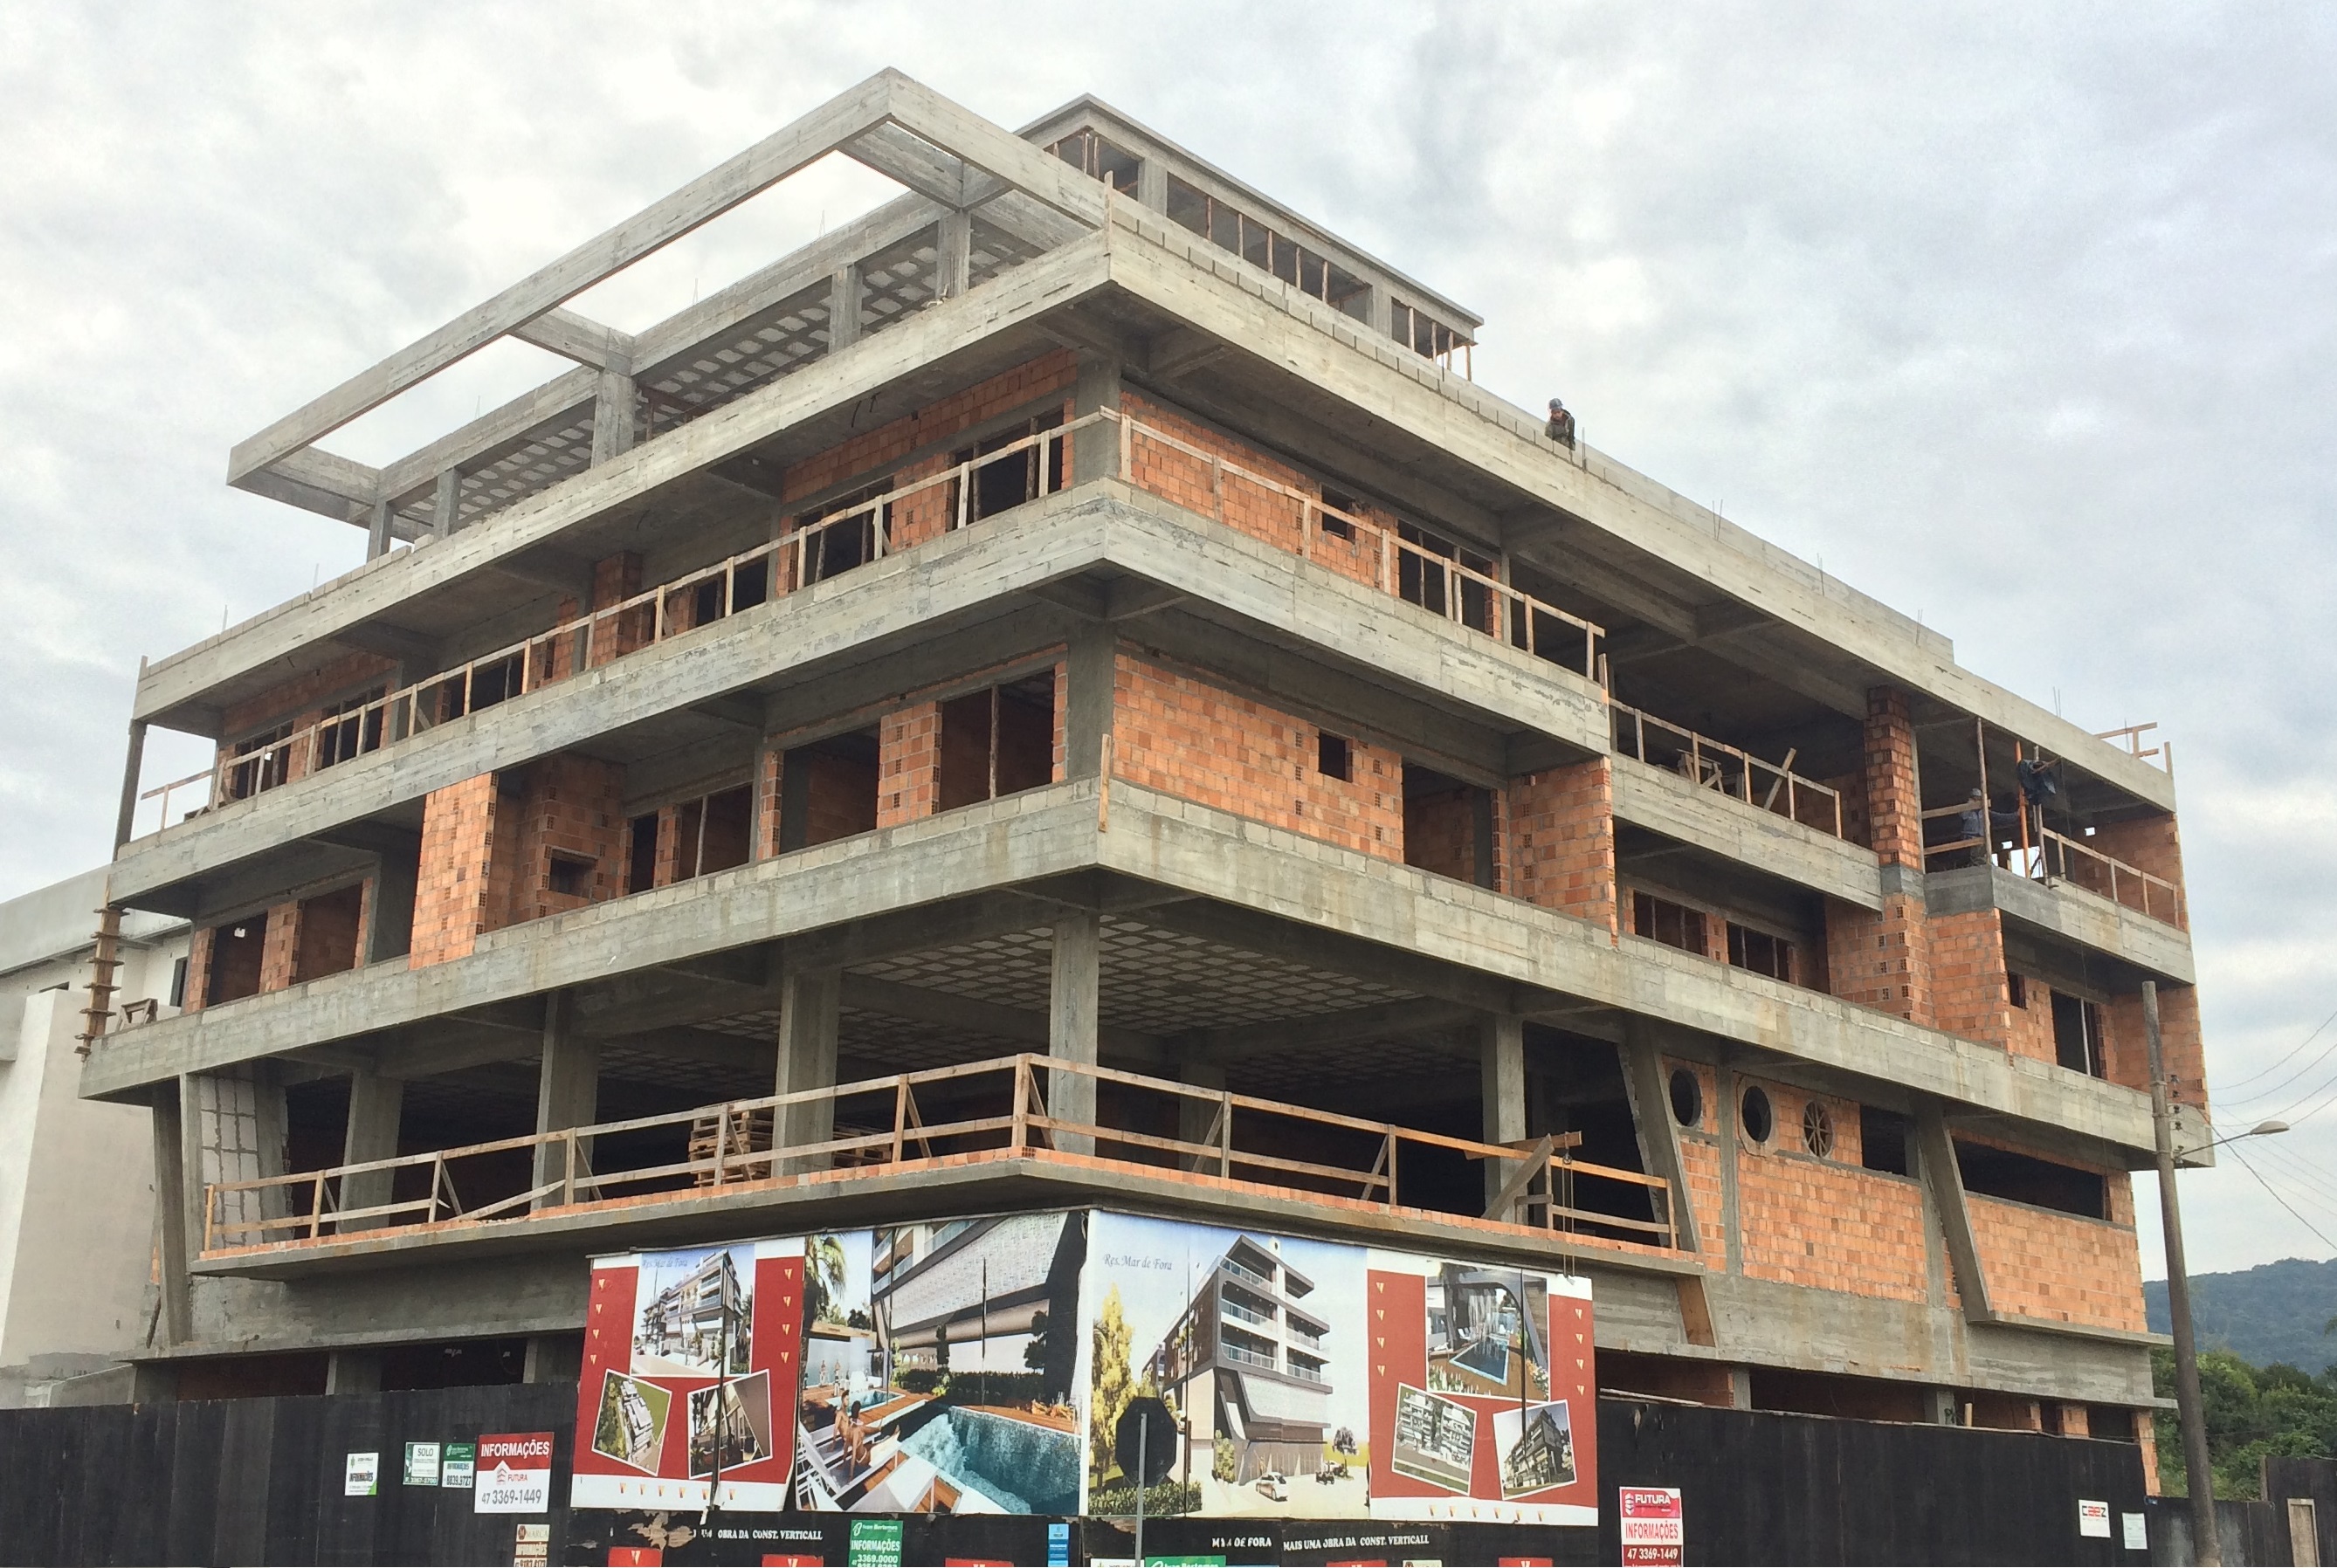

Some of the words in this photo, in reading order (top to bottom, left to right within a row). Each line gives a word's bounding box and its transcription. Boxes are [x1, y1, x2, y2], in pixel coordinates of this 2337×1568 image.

[1121, 1255, 1141, 1267] Mar
[1141, 1255, 1152, 1269] de
[1153, 1259, 1173, 1270] Fora
[417, 1448, 434, 1457] SOLO
[481, 1439, 550, 1459] INFORMAÇÕES
[507, 1474, 528, 1482] FUTURA
[481, 1492, 491, 1504] 47
[1635, 1494, 1671, 1504] FUTURA
[717, 1530, 738, 1539] OBRA
[738, 1530, 749, 1539] DA
[752, 1530, 779, 1540] CONST.
[780, 1530, 823, 1540] VERTICALL
[1625, 1520, 1679, 1543] INFORMAÇÕES
[851, 1538, 900, 1554] INFORMAÇÕES
[1247, 1537, 1272, 1547] FORA
[1283, 1541, 1303, 1551] MAIS
[1303, 1540, 1321, 1550] UMA
[1345, 1537, 1356, 1546] DA
[1360, 1537, 1387, 1546] CONST.
[1388, 1535, 1430, 1545] VERTICALL
[1627, 1548, 1637, 1560] 47
